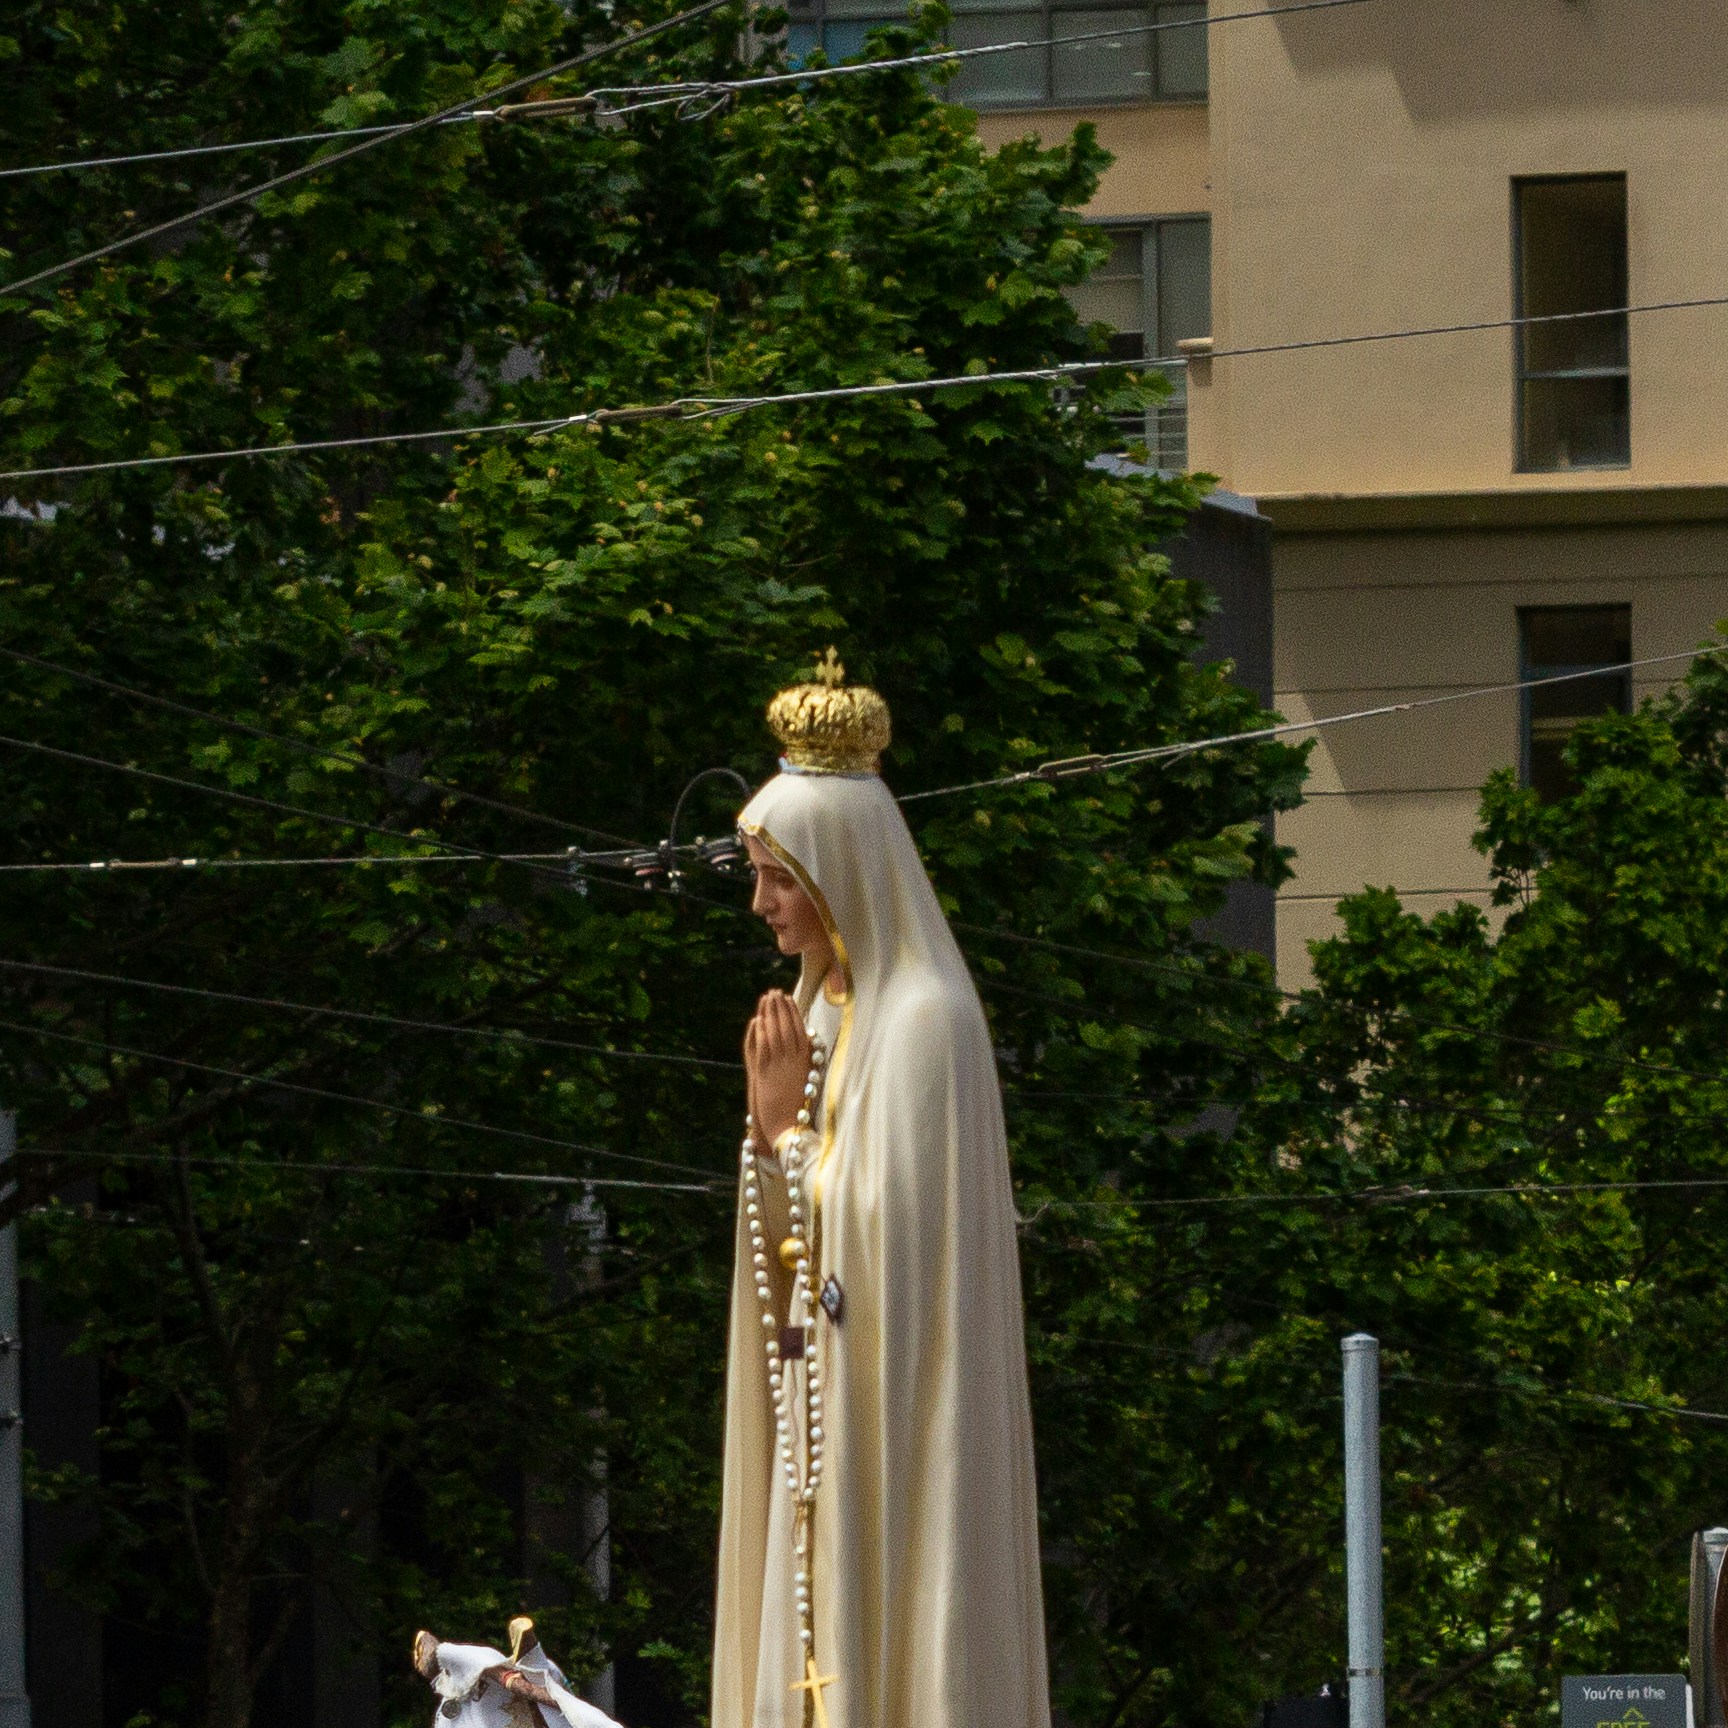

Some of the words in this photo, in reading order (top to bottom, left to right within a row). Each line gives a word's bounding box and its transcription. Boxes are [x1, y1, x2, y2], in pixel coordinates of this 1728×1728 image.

[1582, 1685, 1624, 1700] You're
[1627, 1685, 1640, 1699] in
[1643, 1685, 1666, 1700] the
